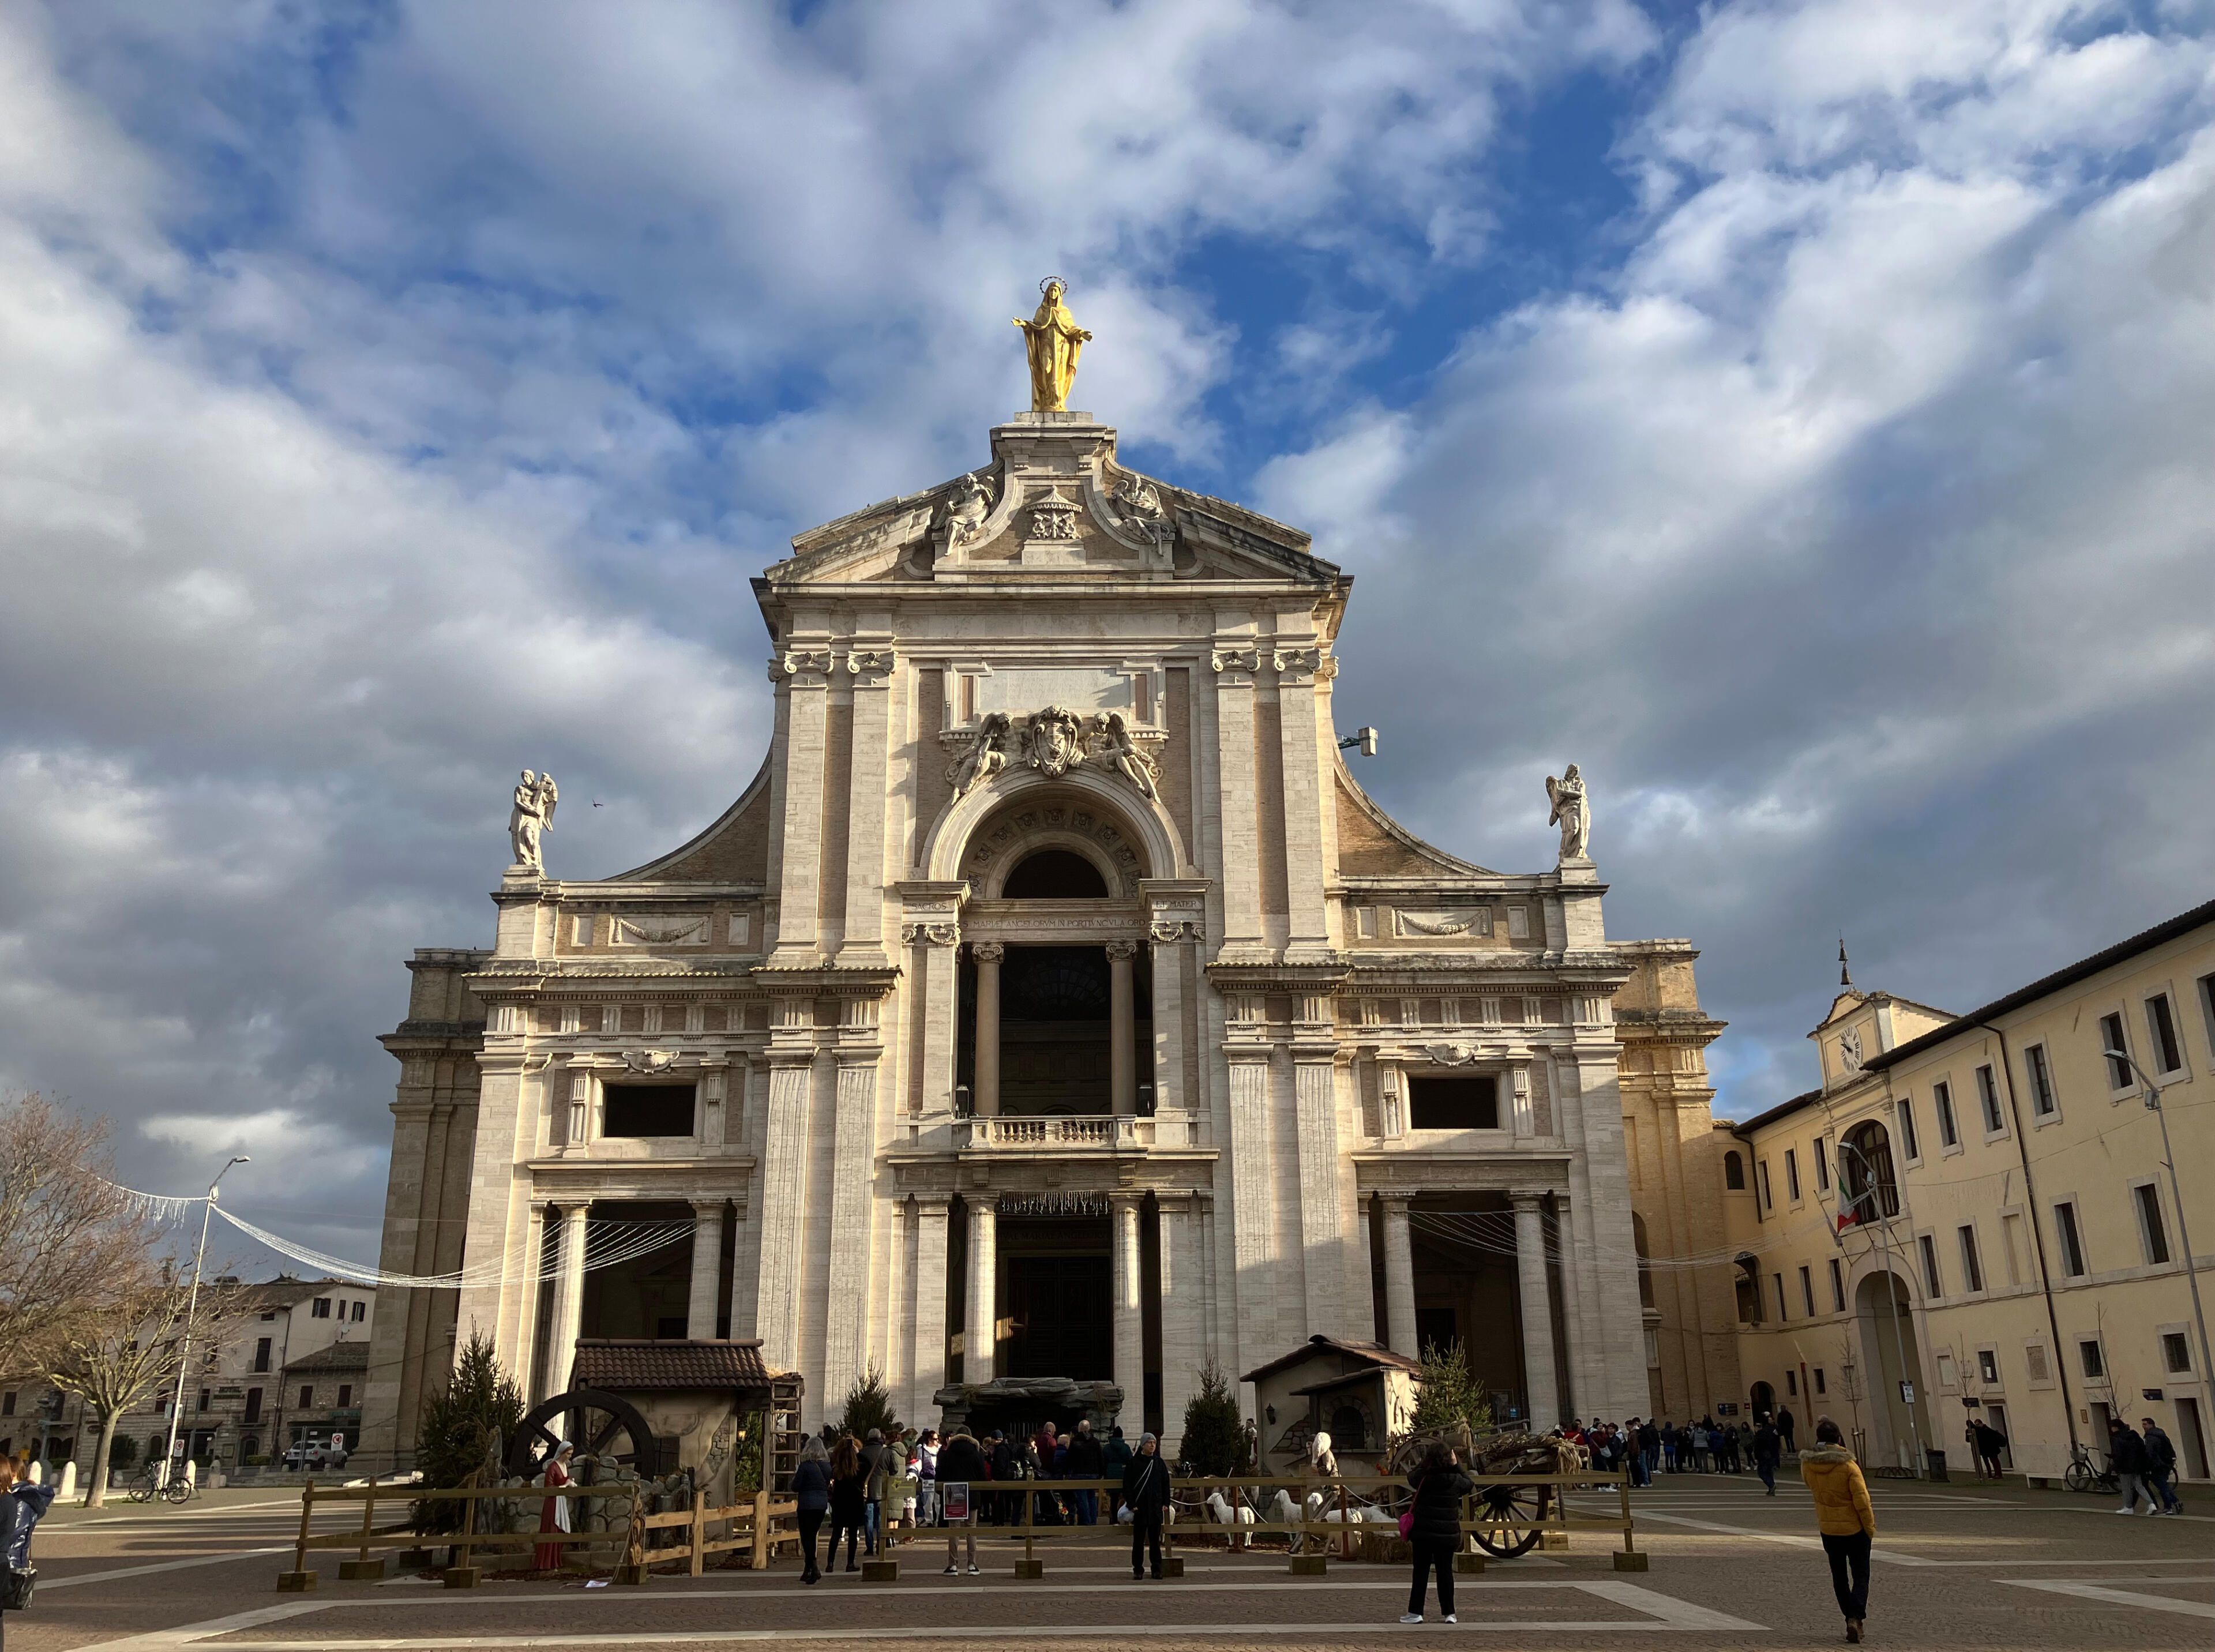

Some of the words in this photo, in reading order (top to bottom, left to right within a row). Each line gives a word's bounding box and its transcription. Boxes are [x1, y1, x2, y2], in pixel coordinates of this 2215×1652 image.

[963, 920, 968, 928] S
[1006, 919, 1056, 928] ANGELORVM
[1067, 919, 1125, 928] PORTIVNCVLA
[1127, 919, 1146, 927] ORD
